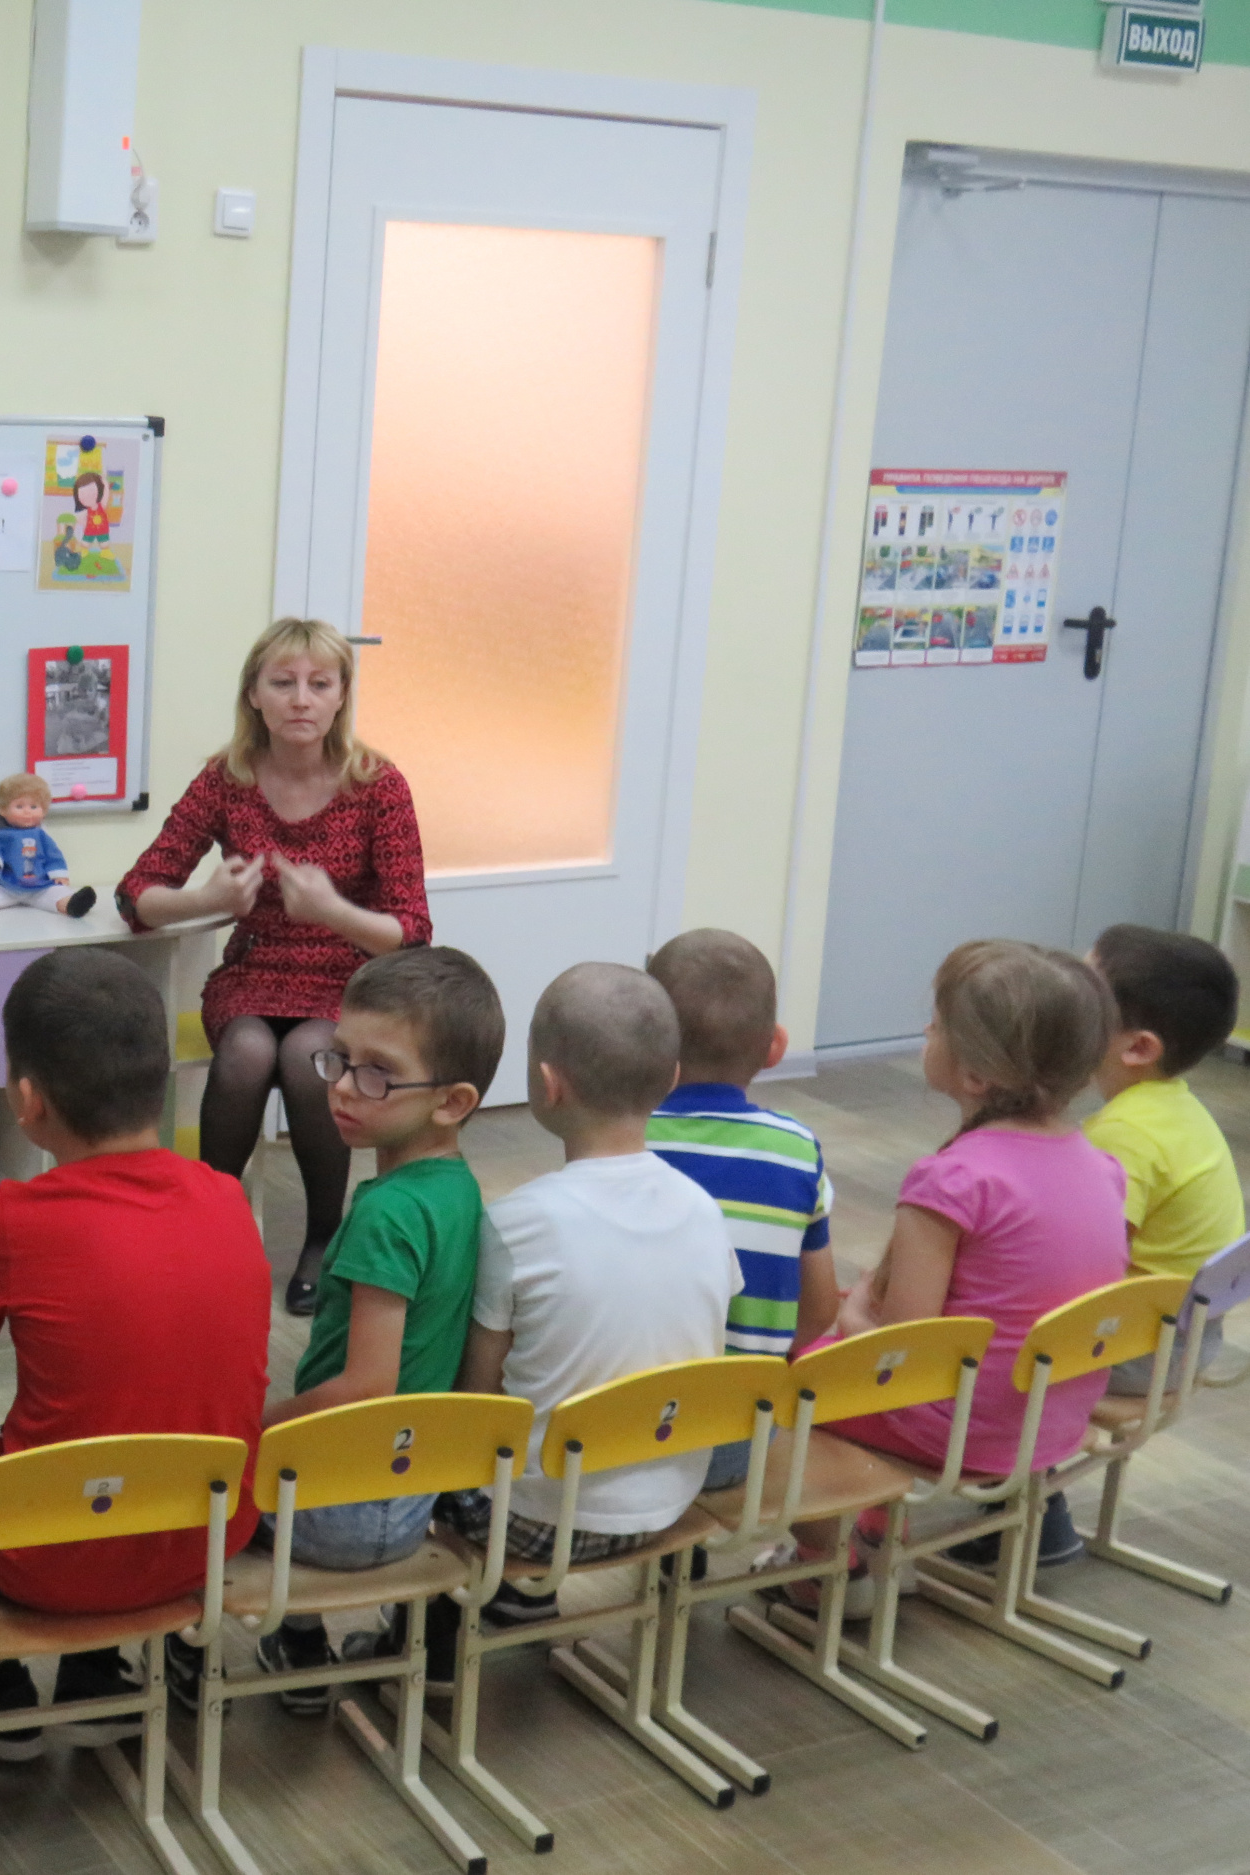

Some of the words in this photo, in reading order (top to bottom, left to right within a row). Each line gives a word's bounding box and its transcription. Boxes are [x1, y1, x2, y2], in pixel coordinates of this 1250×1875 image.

[1129, 23, 1196, 62] ВЫХОД
[664, 1400, 678, 1422] 2
[396, 1428, 412, 1451] 2
[97, 1481, 110, 1495] 2
